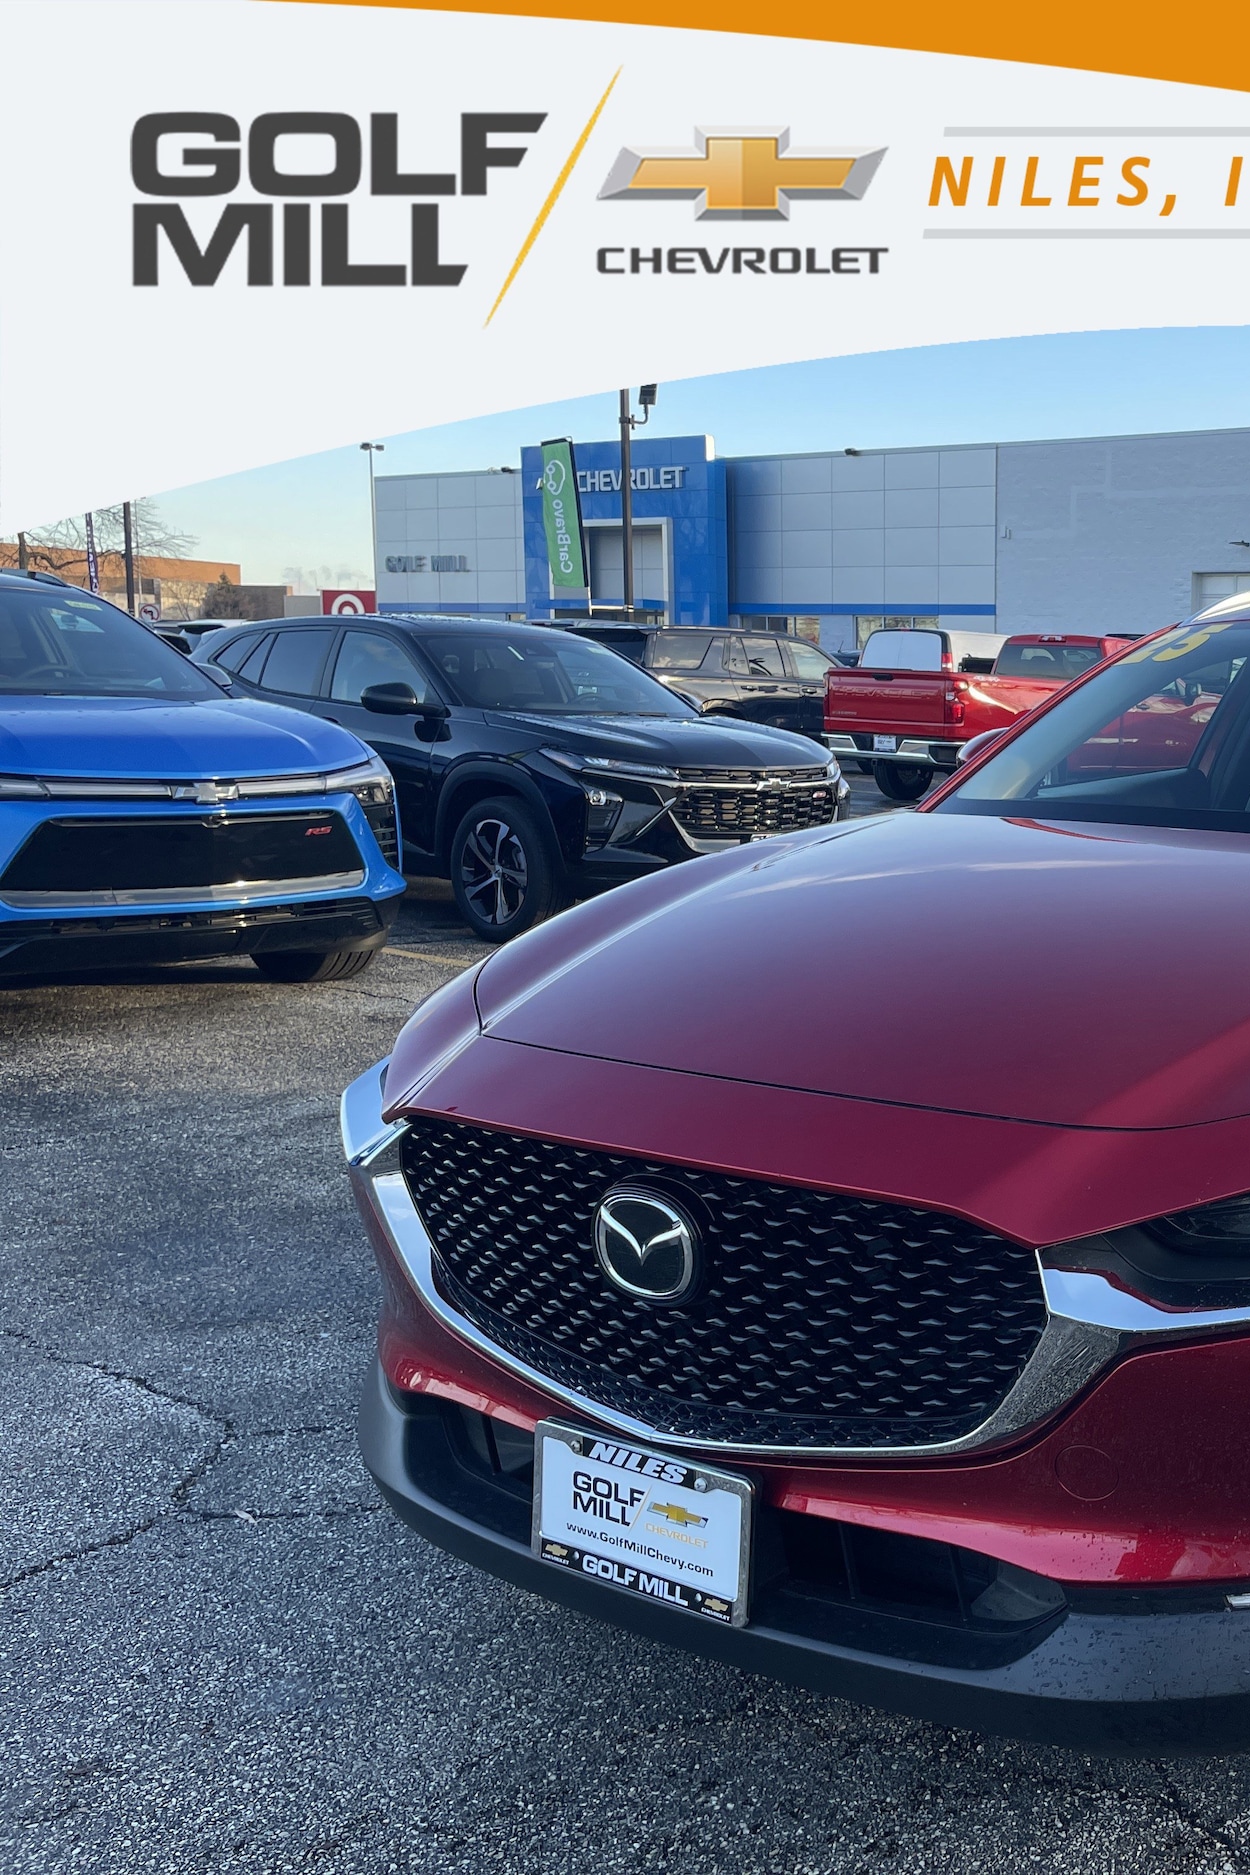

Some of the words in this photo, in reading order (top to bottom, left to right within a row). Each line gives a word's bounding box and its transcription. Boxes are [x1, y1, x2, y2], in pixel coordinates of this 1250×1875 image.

[305, 826, 332, 836] RS
[588, 1441, 688, 1484] NILES
[573, 1471, 645, 1507] GOLF
[573, 1491, 631, 1527] MILL
[566, 1521, 714, 1578] www.GolfMillChevy.com
[645, 1522, 709, 1549] CHEVROLET
[582, 1554, 637, 1585] GOLF
[639, 1574, 688, 1607] MILL
